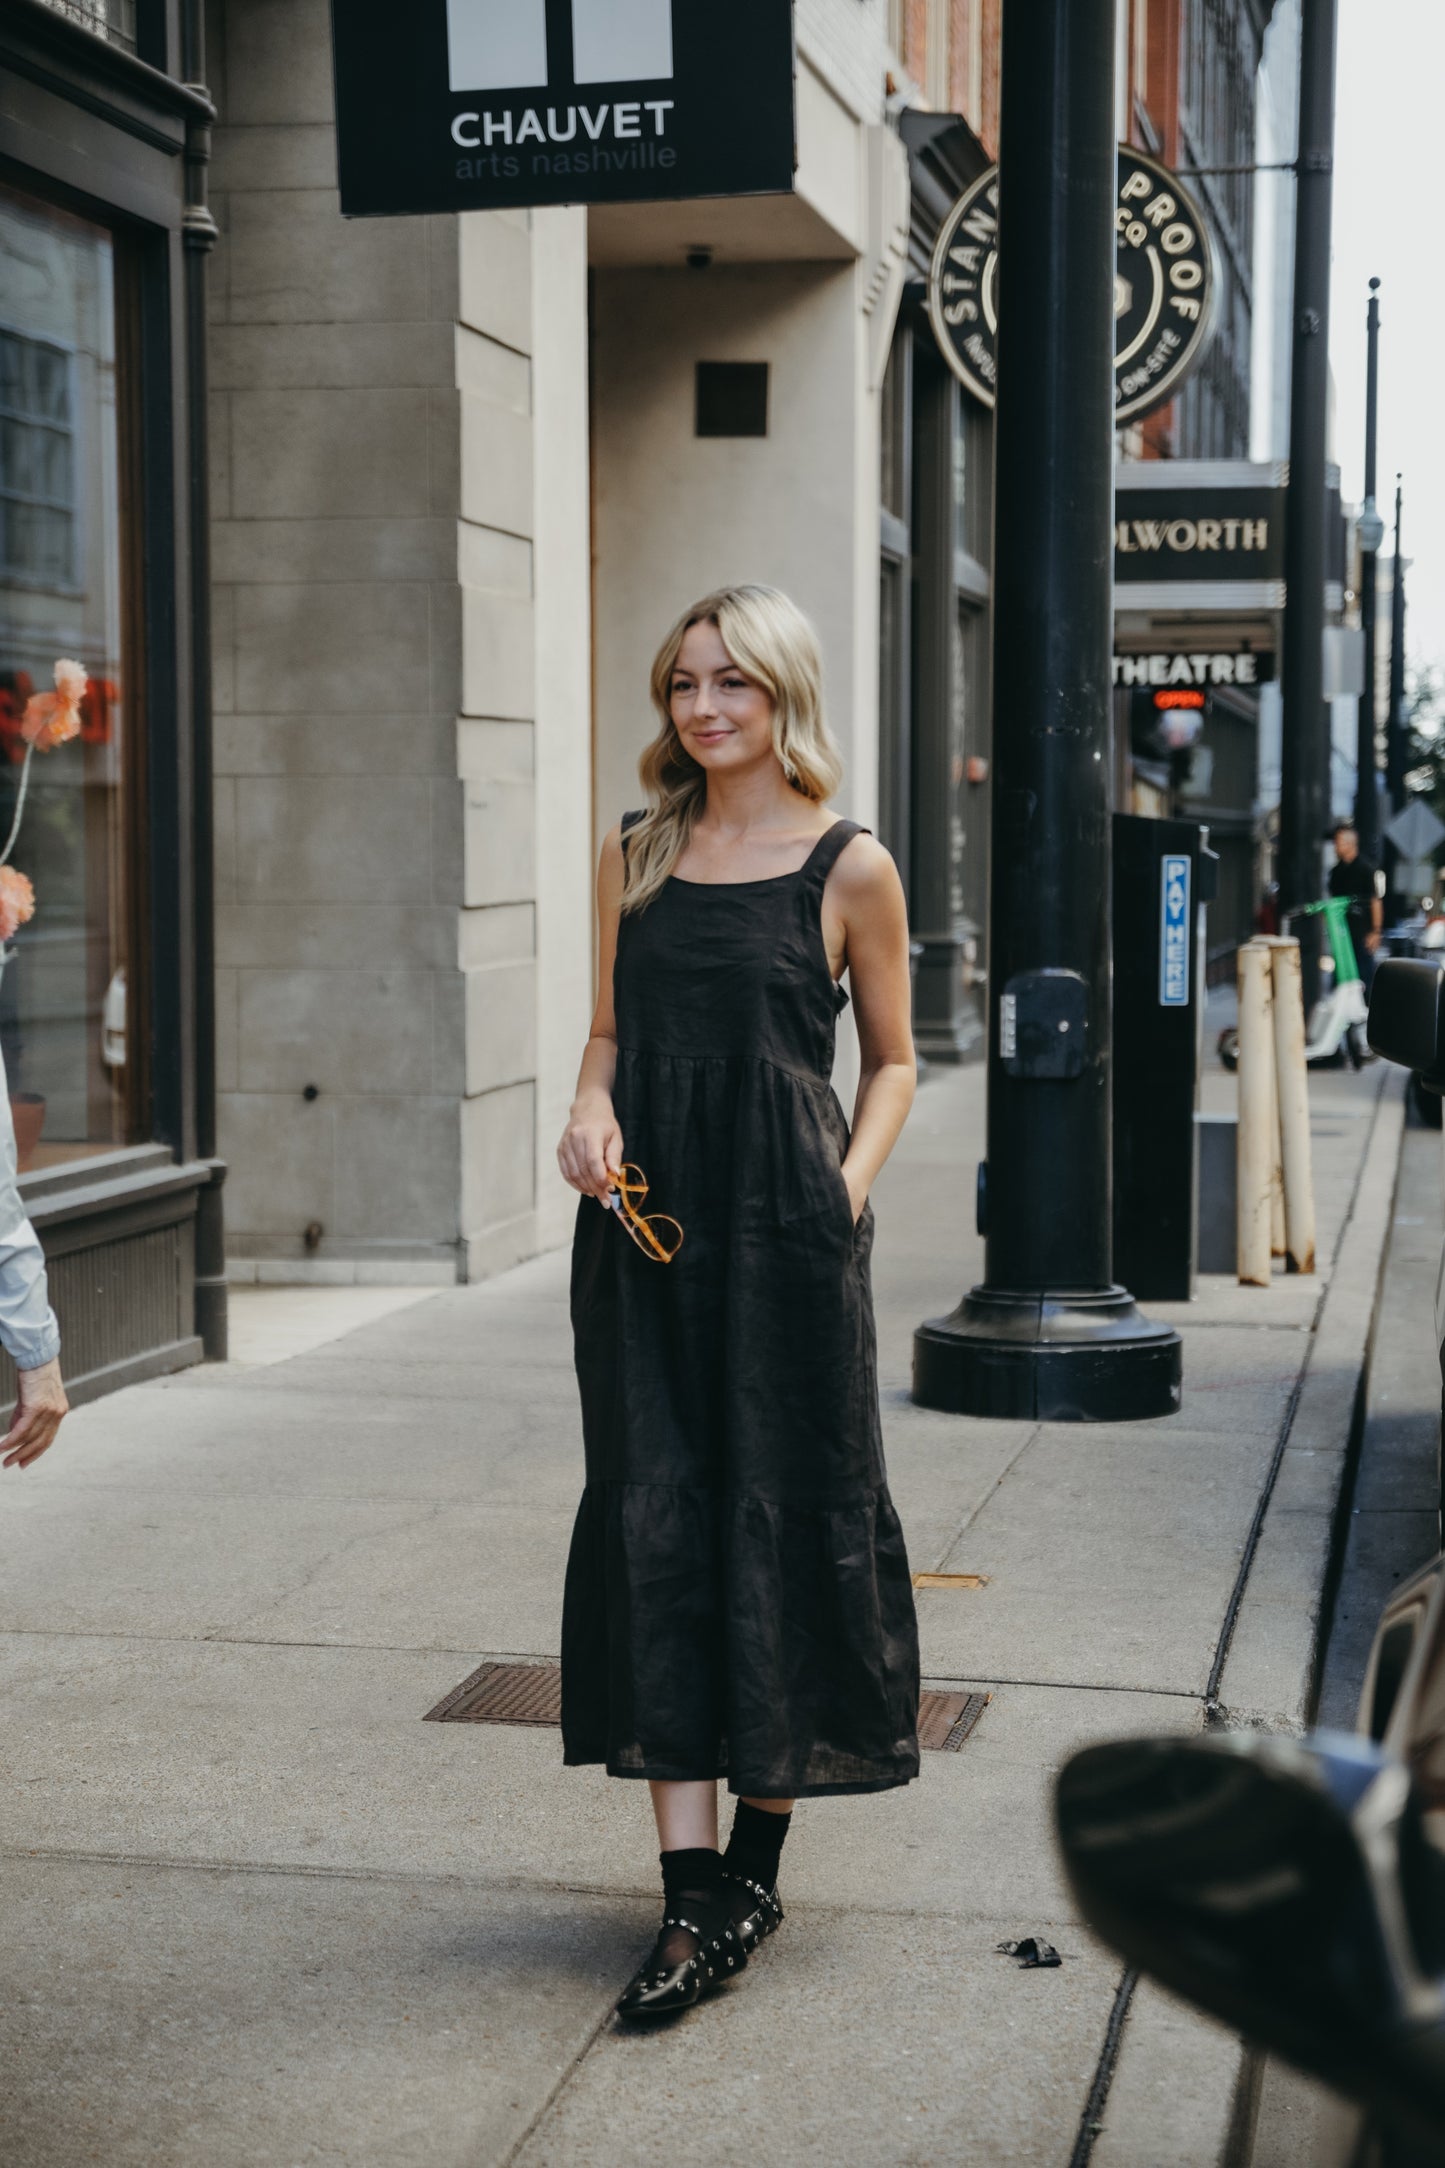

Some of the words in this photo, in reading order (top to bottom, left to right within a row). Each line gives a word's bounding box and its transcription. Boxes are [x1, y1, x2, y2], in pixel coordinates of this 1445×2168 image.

[451, 100, 675, 148] CHAUVET
[455, 152, 520, 180] arts
[531, 142, 677, 175] nashville
[1120, 170, 1203, 321] PROOF
[1120, 327, 1182, 397] ON-SITE
[1115, 518, 1268, 552] LWORTH
[1112, 653, 1257, 686] THEATRE
[1167, 861, 1186, 919] PAY
[1165, 923, 1184, 999] HERE
